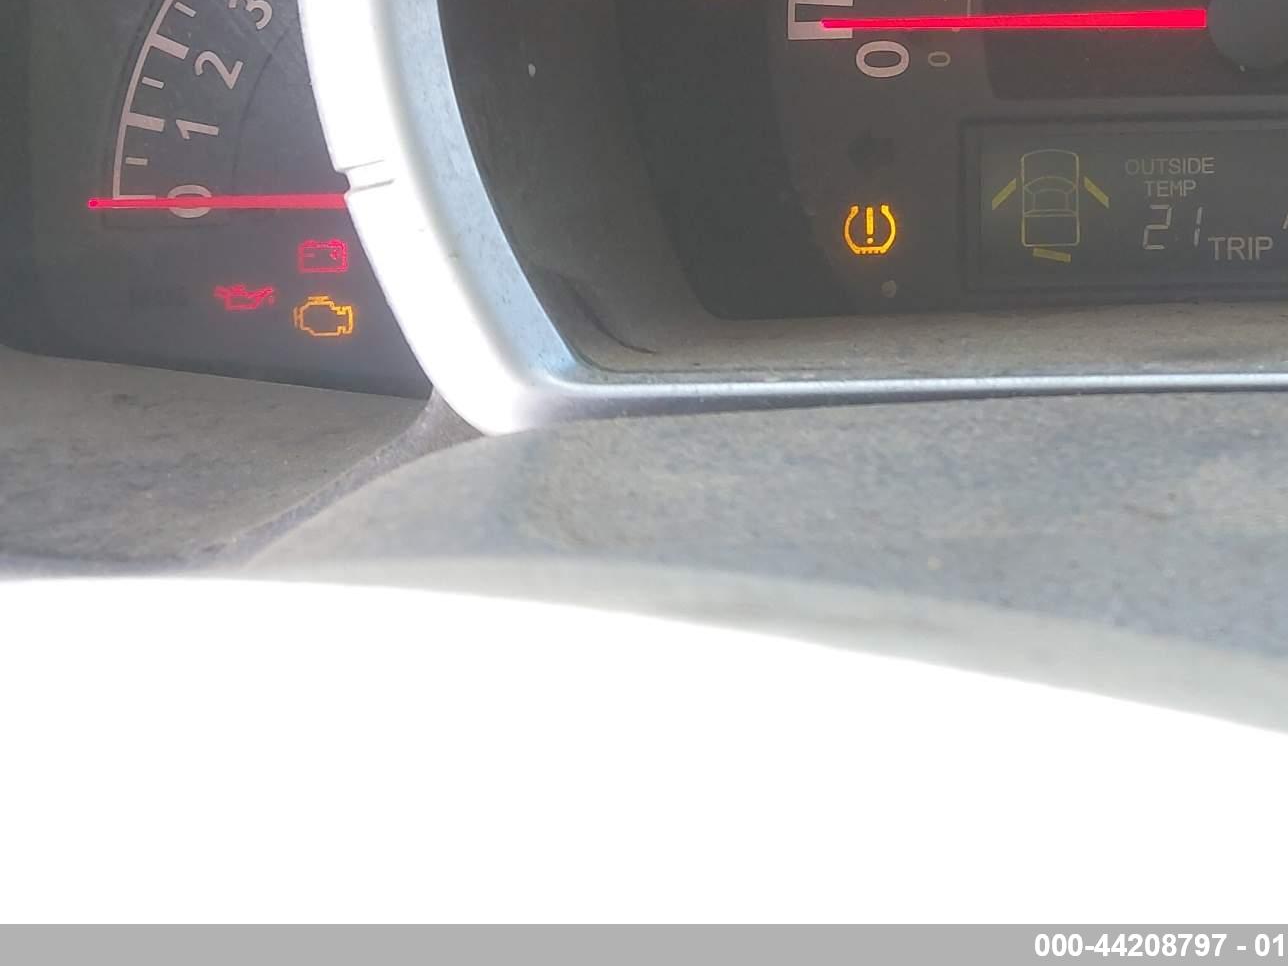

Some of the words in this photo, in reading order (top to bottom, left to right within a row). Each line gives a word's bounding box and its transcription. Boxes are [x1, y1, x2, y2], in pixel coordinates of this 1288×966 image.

[194, 50, 243, 89] 2
[855, 40, 910, 78] 0
[928, 51, 951, 67] 0
[176, 117, 219, 140] 1
[1125, 156, 1215, 176] OUTSIDE
[1145, 180, 1197, 197] TEMP
[167, 184, 212, 219] 0
[1142, 204, 1203, 250] 21
[1207, 236, 1273, 261] TRIP
